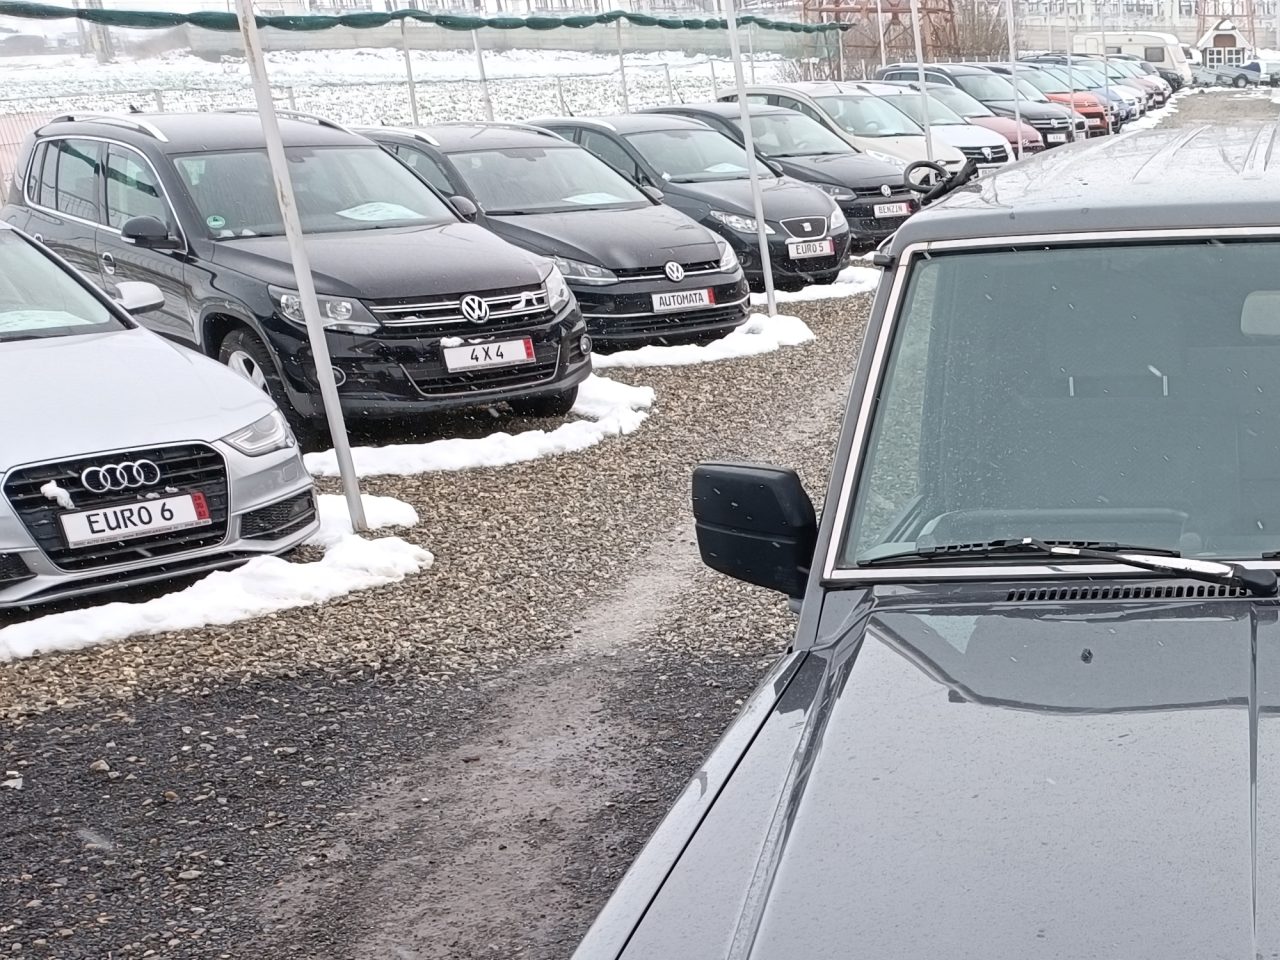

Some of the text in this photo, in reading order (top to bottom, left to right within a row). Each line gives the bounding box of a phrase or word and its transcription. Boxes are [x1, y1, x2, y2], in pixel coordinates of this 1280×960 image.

[878, 205, 903, 214] BENZIN
[795, 244, 825, 254] EURO 5
[659, 292, 704, 307] AUTOMATA
[86, 506, 153, 534] EURO
[160, 502, 174, 521] 6
